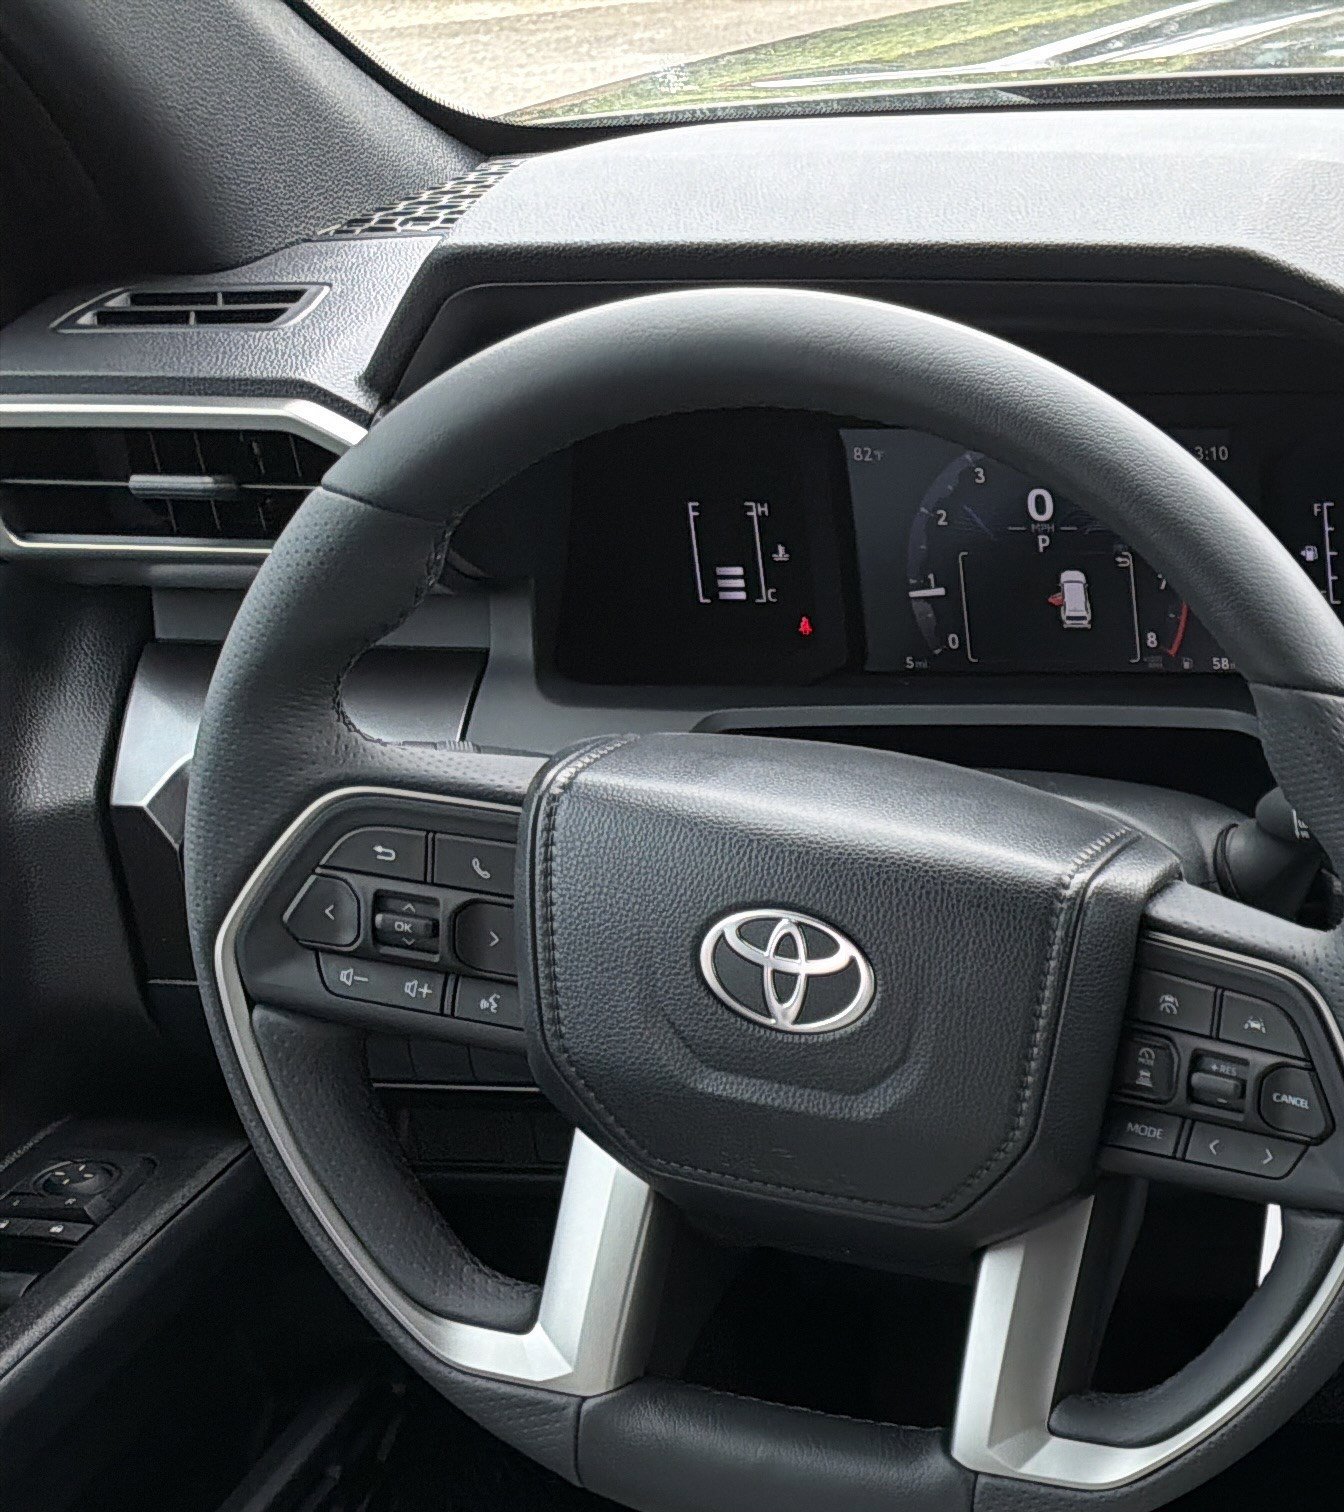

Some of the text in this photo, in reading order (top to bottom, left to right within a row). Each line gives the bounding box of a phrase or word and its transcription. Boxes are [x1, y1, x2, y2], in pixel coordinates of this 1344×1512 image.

[974, 467, 986, 483] 3
[757, 502, 769, 516] H
[1027, 488, 1054, 521] 0
[1313, 503, 1321, 517] F
[936, 509, 949, 526] 2
[1037, 534, 1050, 553] P
[767, 588, 778, 602] C
[947, 633, 960, 650] 0
[1146, 631, 1158, 648] 8
[394, 921, 413, 933] OK
[1272, 1092, 1310, 1110] CANCEL
[1126, 1121, 1165, 1140] MODE
